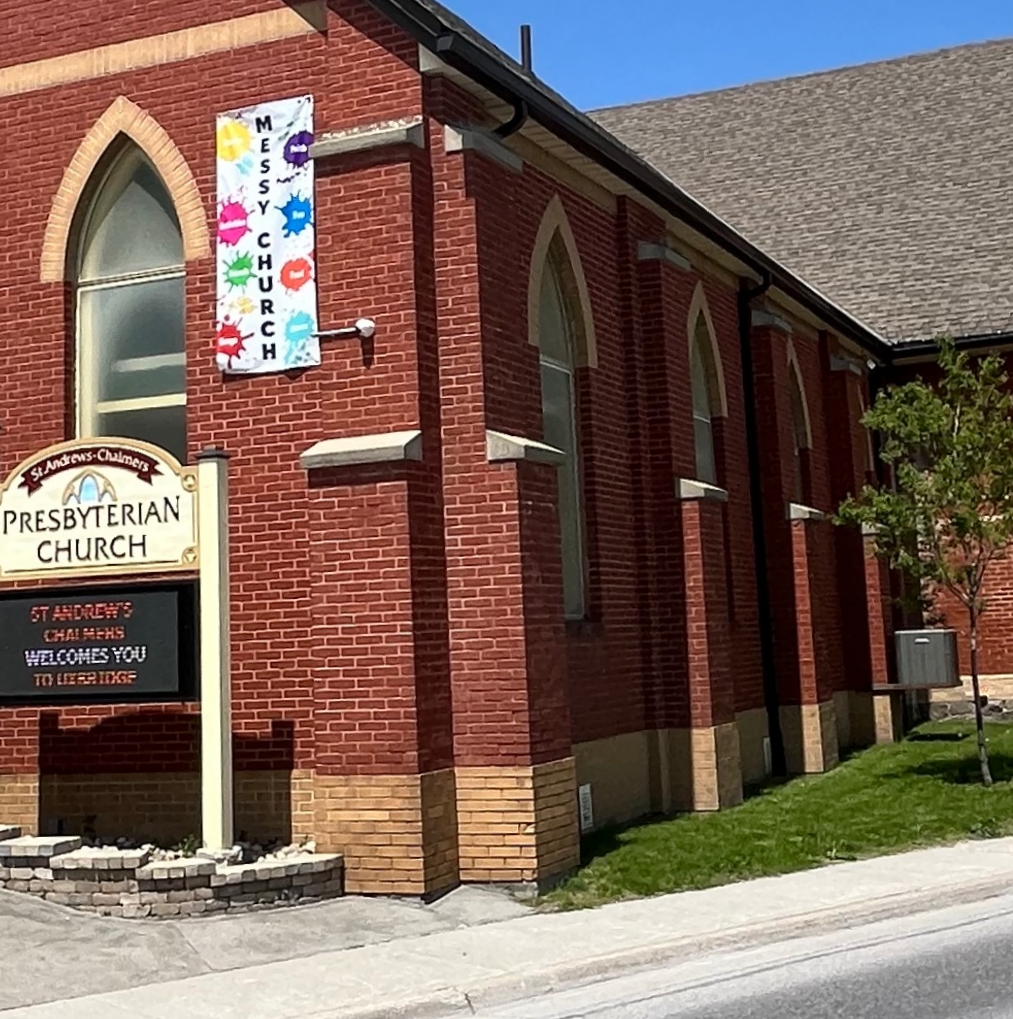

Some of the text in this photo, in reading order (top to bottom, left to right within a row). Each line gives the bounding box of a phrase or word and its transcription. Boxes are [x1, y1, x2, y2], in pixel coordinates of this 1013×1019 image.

[255, 115, 277, 360] MESSY CHURCH
[3, 496, 180, 534] PRESBYTERIAN
[38, 535, 147, 563] CHURCH
[31, 606, 49, 622] ST
[25, 645, 147, 666] WELCOMES YOU
[34, 673, 54, 687] TO
